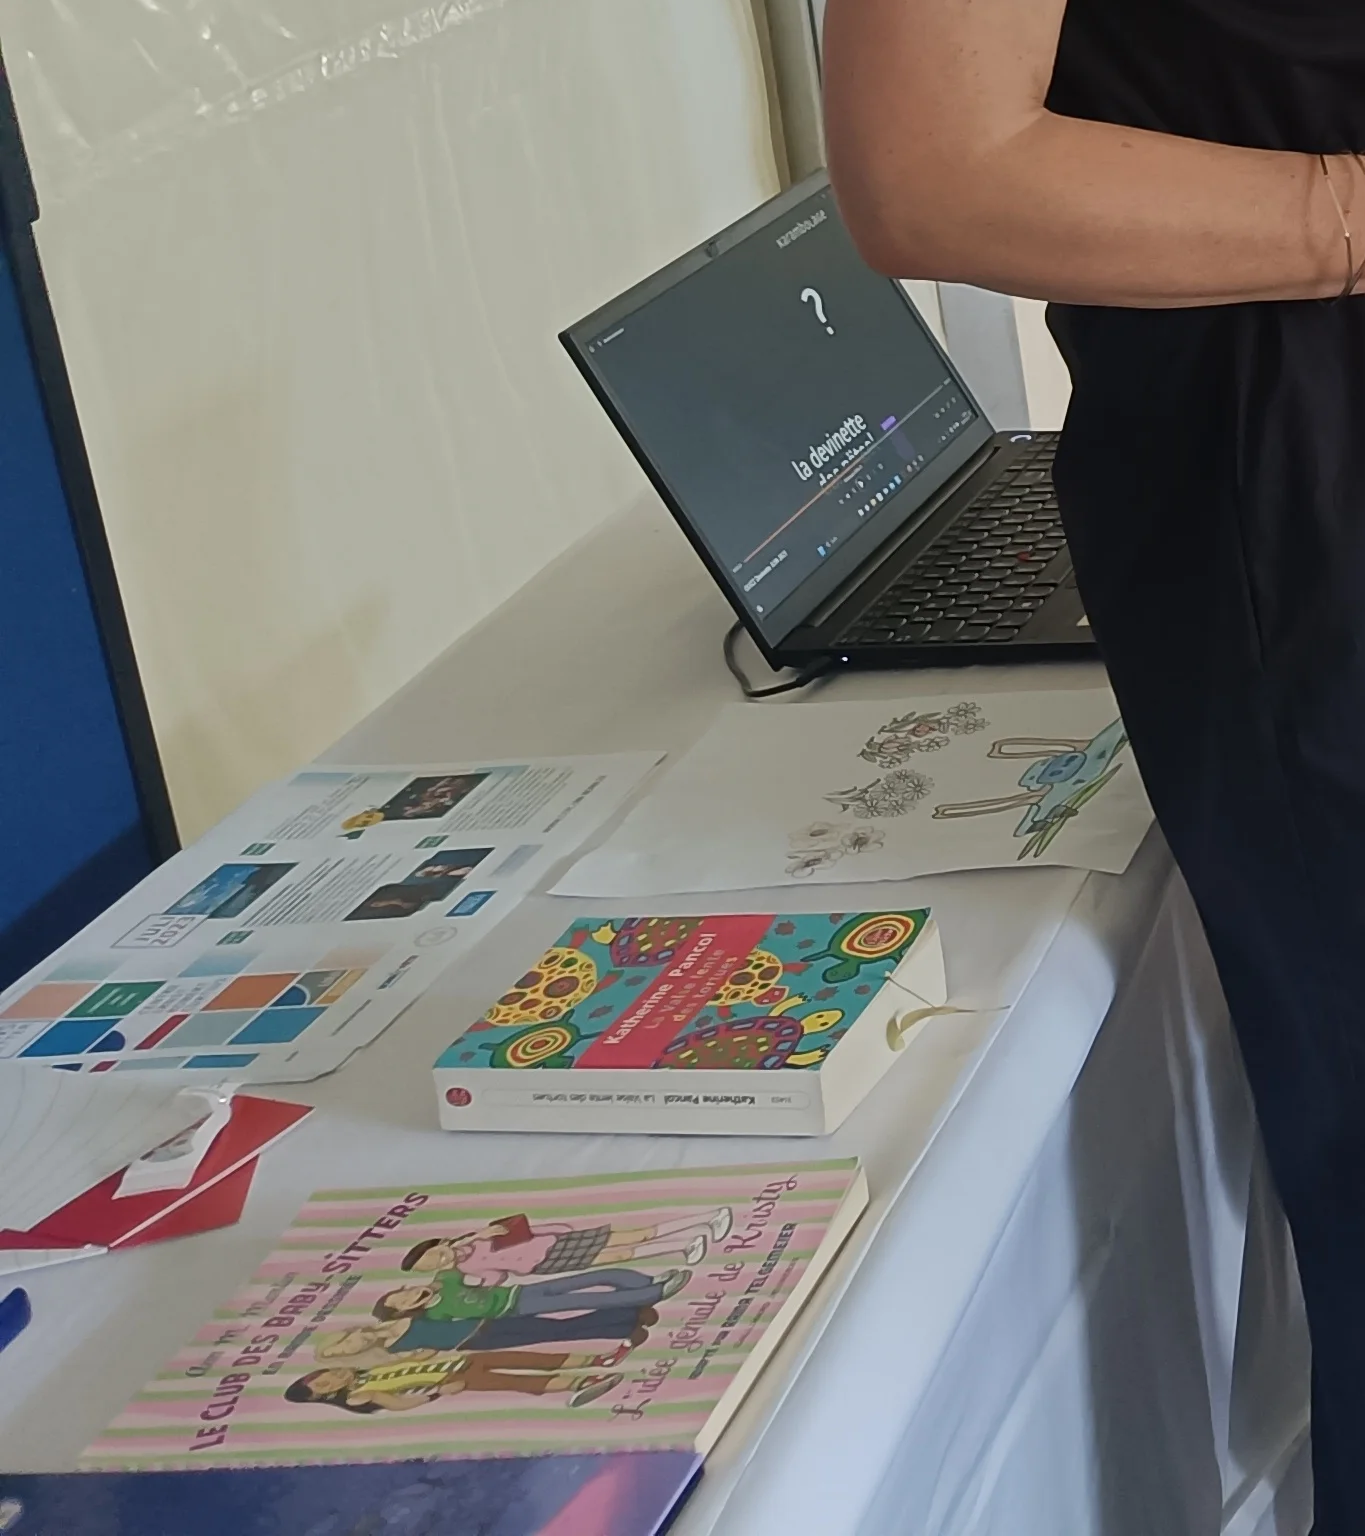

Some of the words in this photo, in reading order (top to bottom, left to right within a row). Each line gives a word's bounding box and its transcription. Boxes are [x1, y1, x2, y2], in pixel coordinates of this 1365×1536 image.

[801, 287, 835, 335] ?
[791, 460, 813, 482] la
[809, 414, 867, 475] devinette
[134, 916, 177, 941] JULI
[149, 916, 197, 945] 2023
[603, 983, 674, 1044] Katherine
[668, 933, 717, 977] Pancol
[643, 1016, 665, 1029] La
[658, 983, 696, 1013] Valse
[690, 949, 725, 979] lente
[673, 1003, 698, 1022] des
[692, 956, 738, 998] tortues
[663, 1094, 700, 1106] Pancol
[702, 1094, 756, 1106] Katherine
[723, 1173, 798, 1254] Kristy
[708, 1261, 745, 1282] de
[744, 1222, 798, 1295] TELGEMEIER
[668, 1288, 727, 1354] géniale
[233, 1333, 280, 1368] DES
[200, 1372, 251, 1421] CLUB
[607, 1357, 678, 1421] L'idée
[188, 1424, 229, 1451] LE
